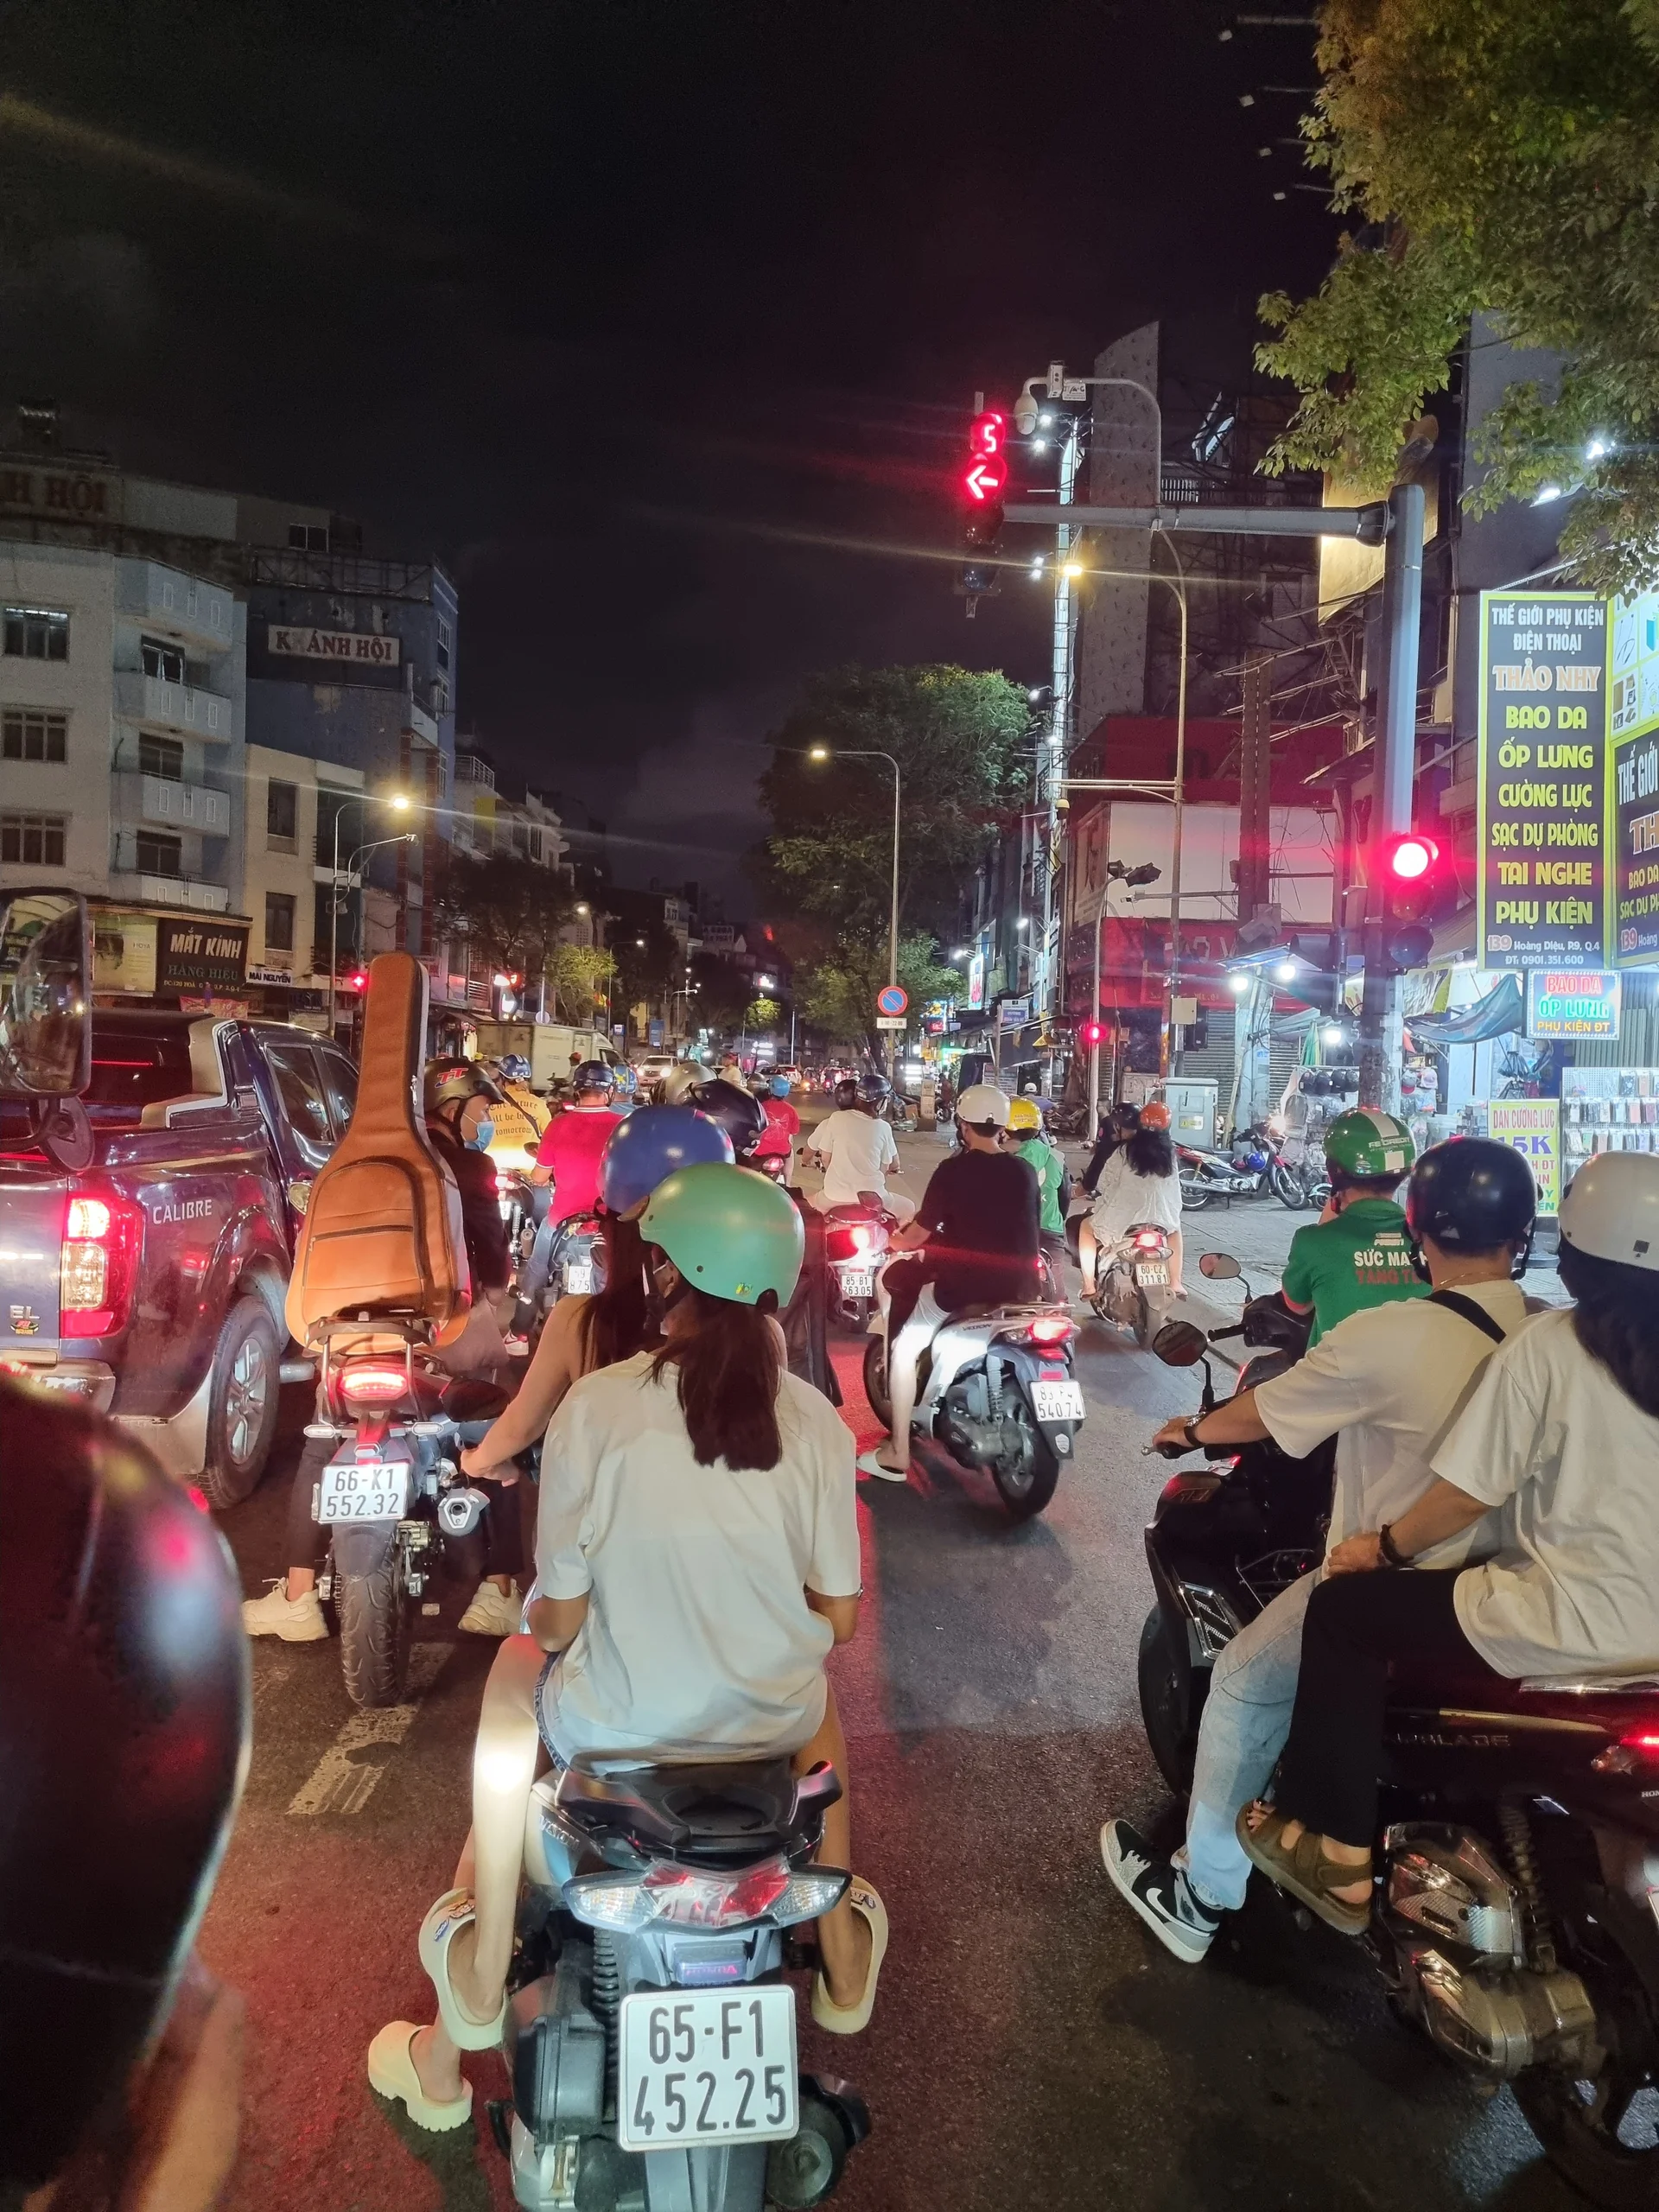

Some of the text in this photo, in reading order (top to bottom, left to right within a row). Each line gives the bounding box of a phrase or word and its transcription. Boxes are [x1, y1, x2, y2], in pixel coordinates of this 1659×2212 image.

[1492, 602, 1604, 629] THẾ GIỚI PHỤ KIỆN
[276, 629, 391, 663] KÁNH HỘI
[1513, 630, 1582, 654] ĐIỆN THOẠI
[1492, 658, 1601, 691] THẢO NHY
[1506, 706, 1587, 729] BAO DA
[1498, 736, 1593, 768] ỐP LƯNG
[1618, 741, 1658, 805] THẾ GIỚI
[1498, 779, 1592, 813] CƯỜNG LỰC
[1491, 818, 1599, 852] SẠC DỰ PHÒNG
[1497, 862, 1592, 886] TAI NGHE
[1629, 864, 1659, 890] BAO DA
[1496, 896, 1593, 930] PHỤ KIỆN
[1620, 901, 1635, 923] SẠC
[1637, 894, 1648, 918] DỰ
[170, 927, 242, 959] MẮT KÍNH
[1487, 934, 1512, 950] 139
[1514, 941, 1541, 952] Hoàng
[1585, 942, 1600, 951] Q.4
[1638, 933, 1658, 947] Hoàng
[168, 963, 238, 982] HÀNG HIỆU
[1522, 956, 1584, 965] 0901.351.600
[1547, 976, 1602, 994] BAO DA
[1539, 993, 1610, 1019] ỐP LƯNG
[1537, 1021, 1560, 1033] PHỤ
[1594, 1022, 1610, 1032] ĐT
[1493, 1105, 1554, 1132] DÁN CƯỜNG LỰC
[1542, 1160, 1554, 1170] ĐT
[1536, 1173, 1550, 1184] IN
[153, 1198, 213, 1224] CALIBRE
[1354, 1249, 1383, 1267] SỨC
[1038, 1402, 1081, 1418] 540.74
[326, 1493, 398, 1516] 552.32
[649, 2000, 764, 2064] 65-F1
[633, 2065, 786, 2135] 452.25
